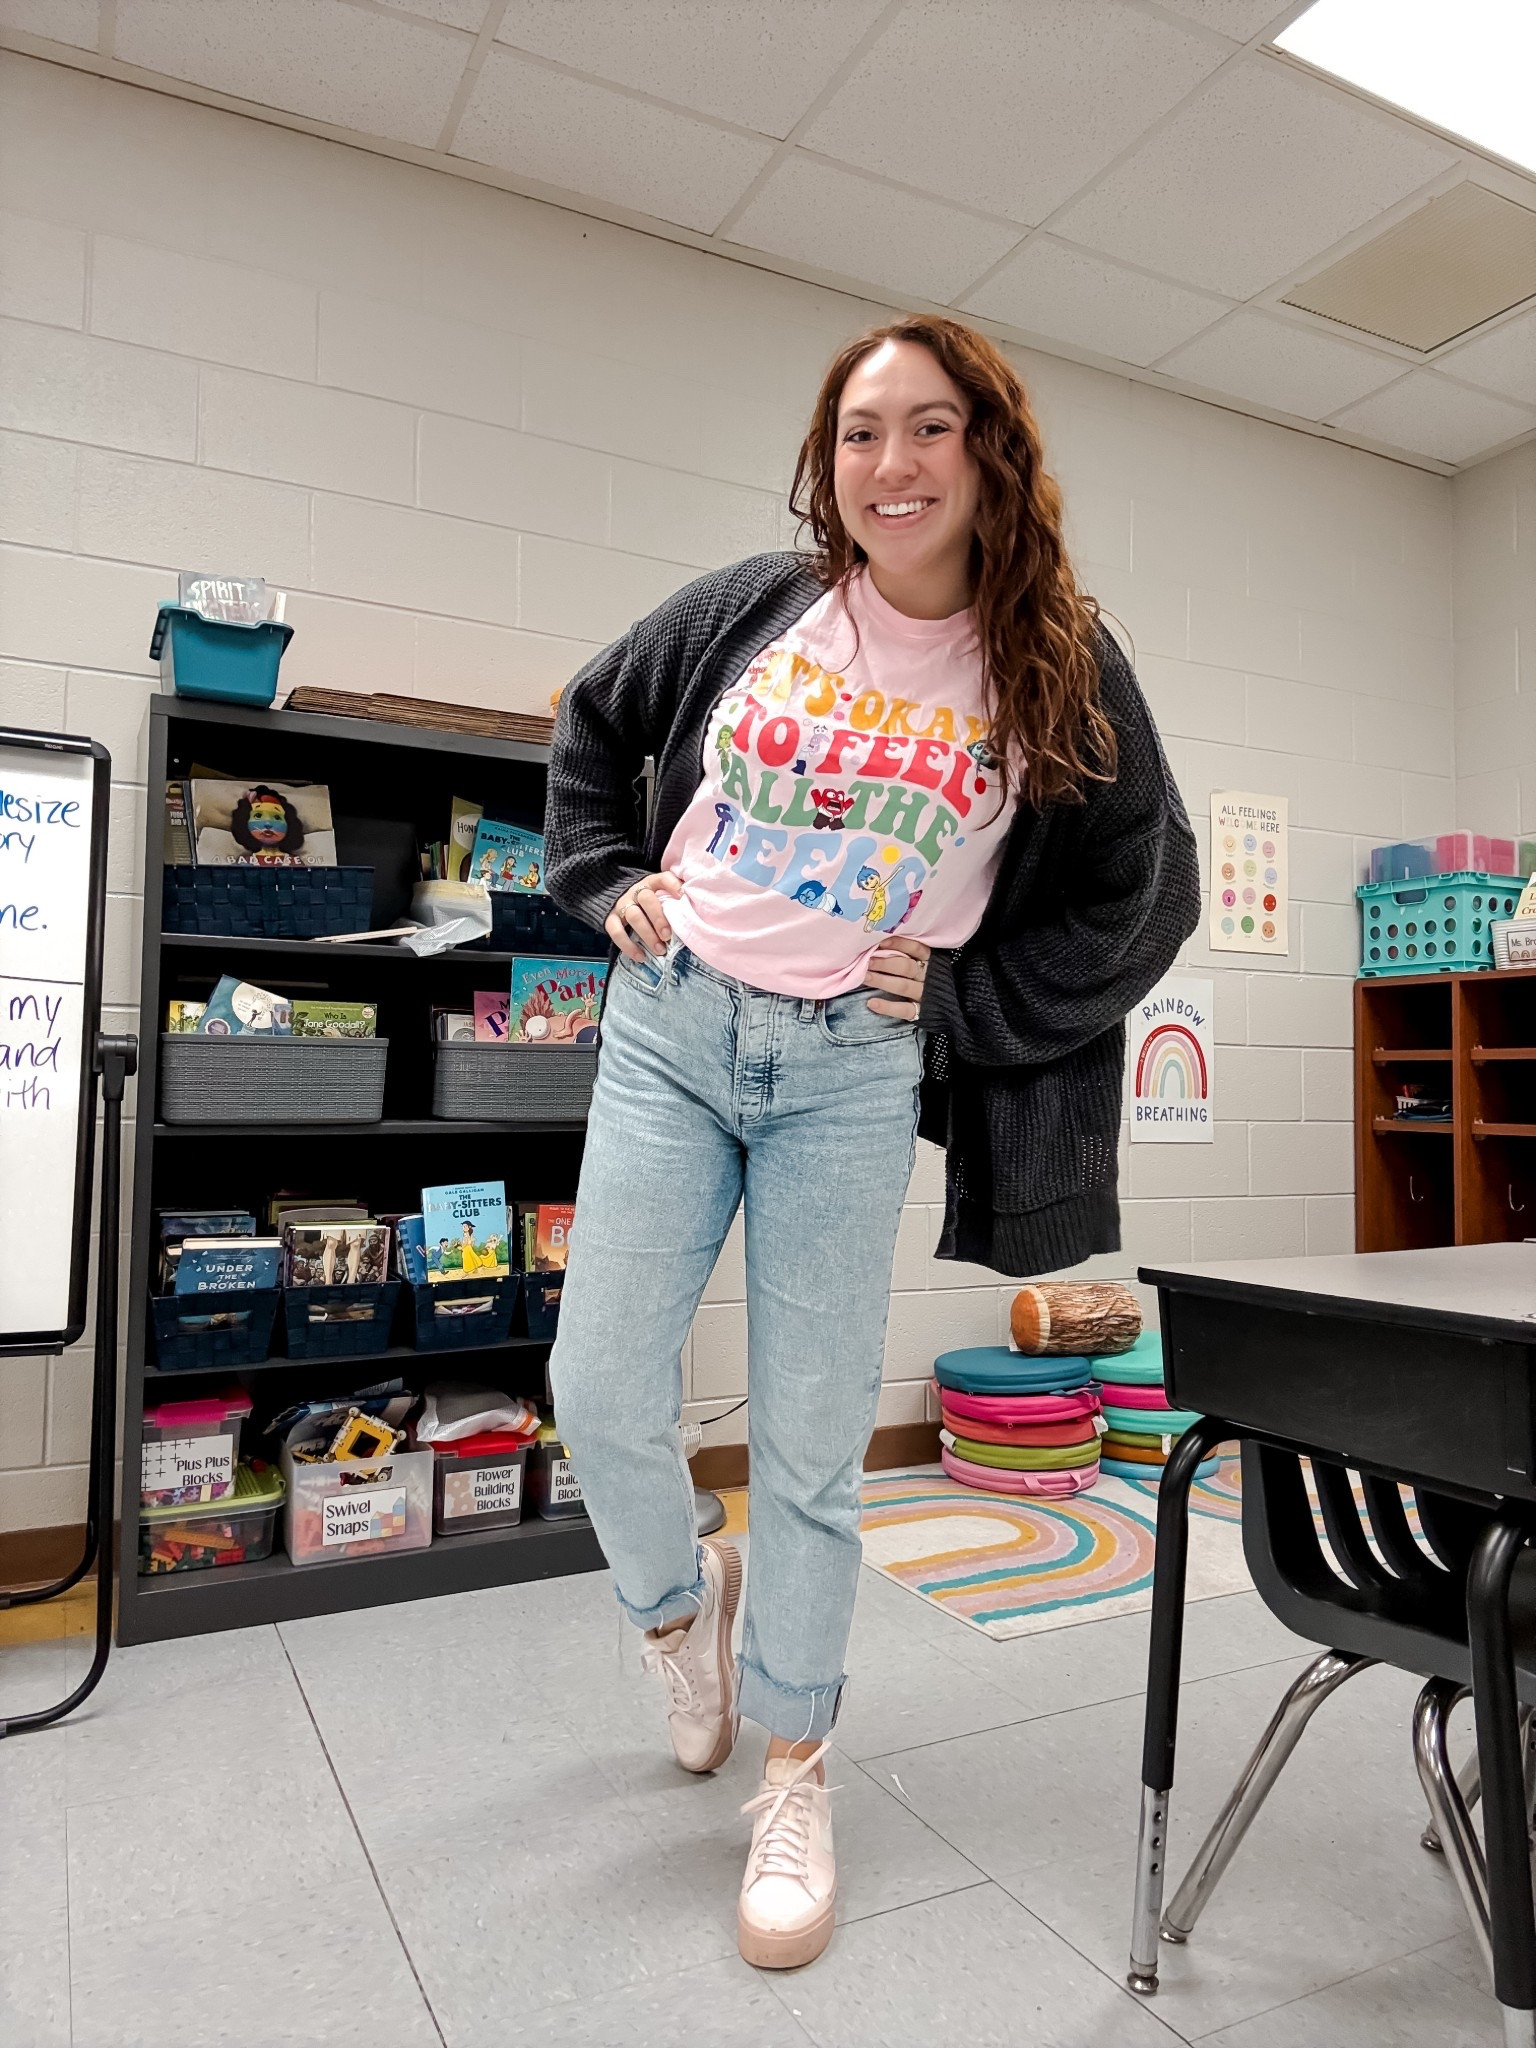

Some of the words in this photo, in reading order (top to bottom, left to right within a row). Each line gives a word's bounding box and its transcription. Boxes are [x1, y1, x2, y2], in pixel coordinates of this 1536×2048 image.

[190, 580, 245, 601] SPIRIT
[755, 652, 845, 717] IT'S
[849, 690, 990, 748] OKAY
[732, 693, 800, 767] TO
[815, 729, 972, 818] FEEL
[722, 753, 815, 826] ALL
[845, 780, 958, 867] THE
[1221, 804, 1236, 815] ALL
[1238, 806, 1277, 821] FEELINGS
[1260, 821, 1280, 834] HERE
[226, 855, 259, 865] BAD
[263, 855, 302, 865] CASE
[713, 802, 926, 931] FEELS
[521, 967, 550, 985] Even
[556, 966, 588, 980] More
[9, 994, 62, 1029] my
[324, 1011, 339, 1019] Who
[340, 1012, 347, 1020] Is
[1142, 998, 1205, 1027] RAINBOW
[303, 1018, 324, 1028] Jane
[325, 1019, 366, 1029] Goodall?
[1, 1076, 51, 1111] ith
[1136, 1105, 1207, 1122] BREATHING
[428, 1197, 502, 1213] BABY-SITTERS
[452, 1208, 480, 1219] CLUB
[555, 1217, 572, 1226] ONE
[206, 1264, 253, 1273] UNDER
[198, 1281, 256, 1291] BROKEN
[176, 1459, 202, 1472] Plus
[205, 1456, 230, 1468] Plus
[182, 1472, 223, 1487] Blocks
[476, 1467, 514, 1483] Flower
[474, 1482, 515, 1498] Building
[326, 1500, 371, 1519] Swivel
[476, 1497, 511, 1511] Blocks
[326, 1520, 370, 1537] Snaps
